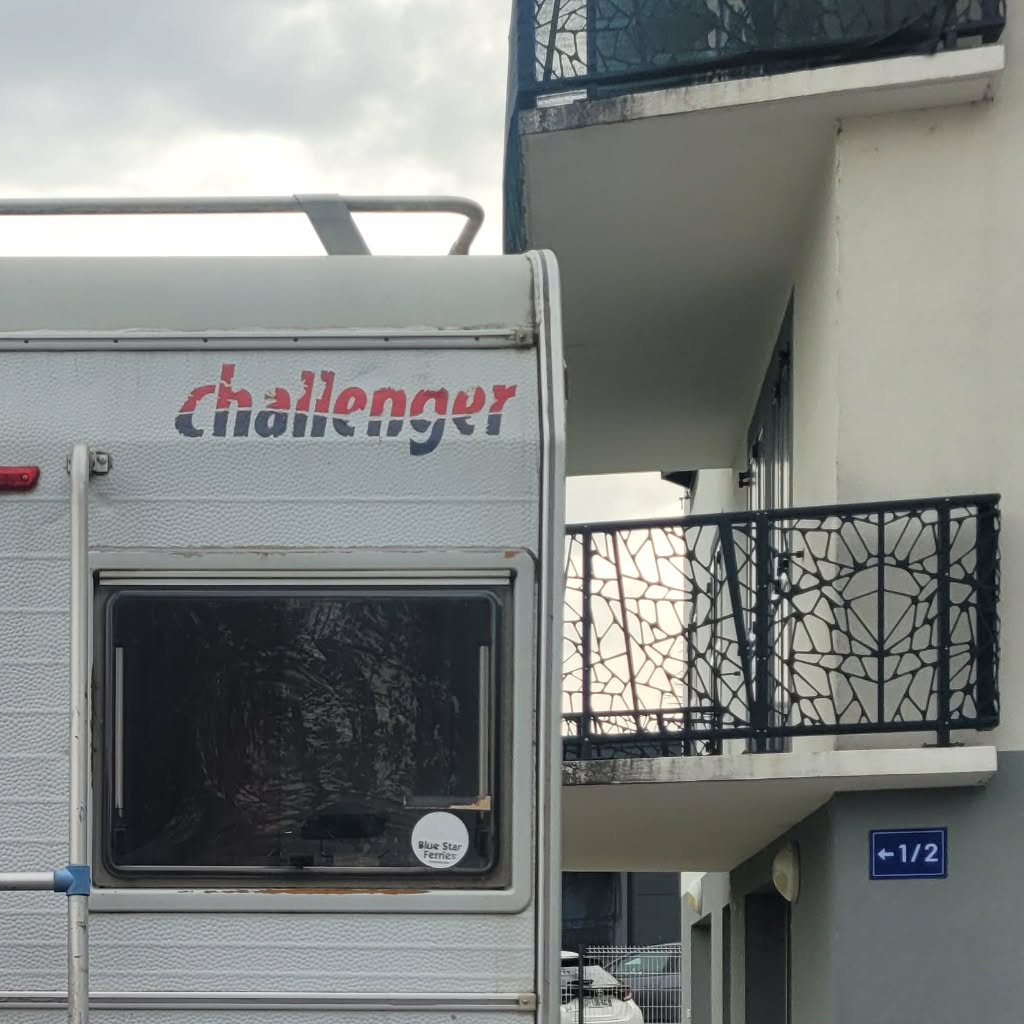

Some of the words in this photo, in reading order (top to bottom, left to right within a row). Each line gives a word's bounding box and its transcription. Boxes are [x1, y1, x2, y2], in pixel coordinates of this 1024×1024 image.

[174, 363, 517, 456] challenger
[418, 840, 440, 850] Blue
[442, 842, 463, 851] Star
[898, 843, 939, 863] 1/2
[423, 850, 457, 860] Ferries
